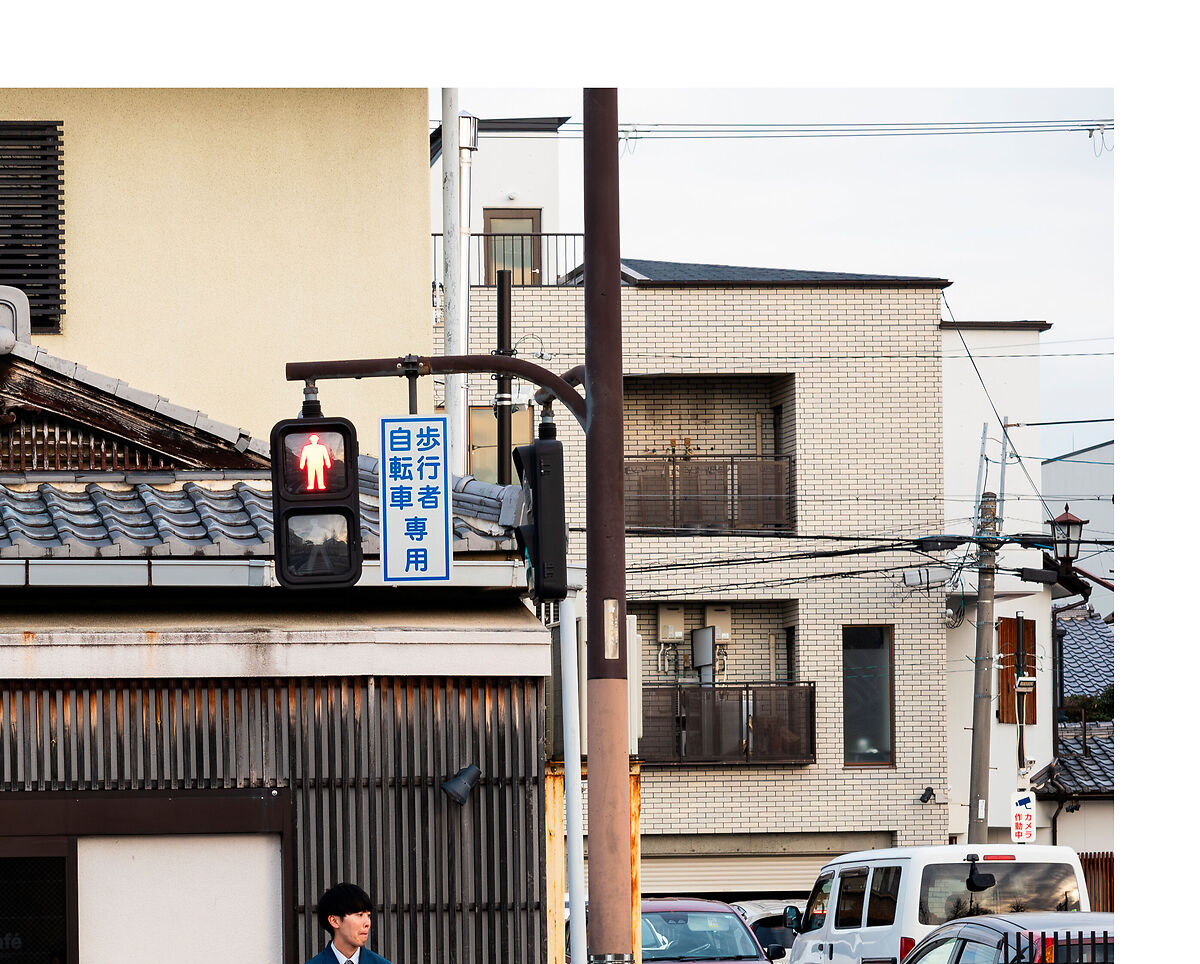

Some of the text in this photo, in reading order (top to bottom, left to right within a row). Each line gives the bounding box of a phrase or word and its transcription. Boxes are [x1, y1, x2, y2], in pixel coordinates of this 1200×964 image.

[389, 427, 413, 511] 自転車
[416, 426, 441, 510] 歩行者
[404, 516, 428, 573] 専用
[1014, 813, 1023, 839] 作動中
[1024, 813, 1032, 839] カメラ
